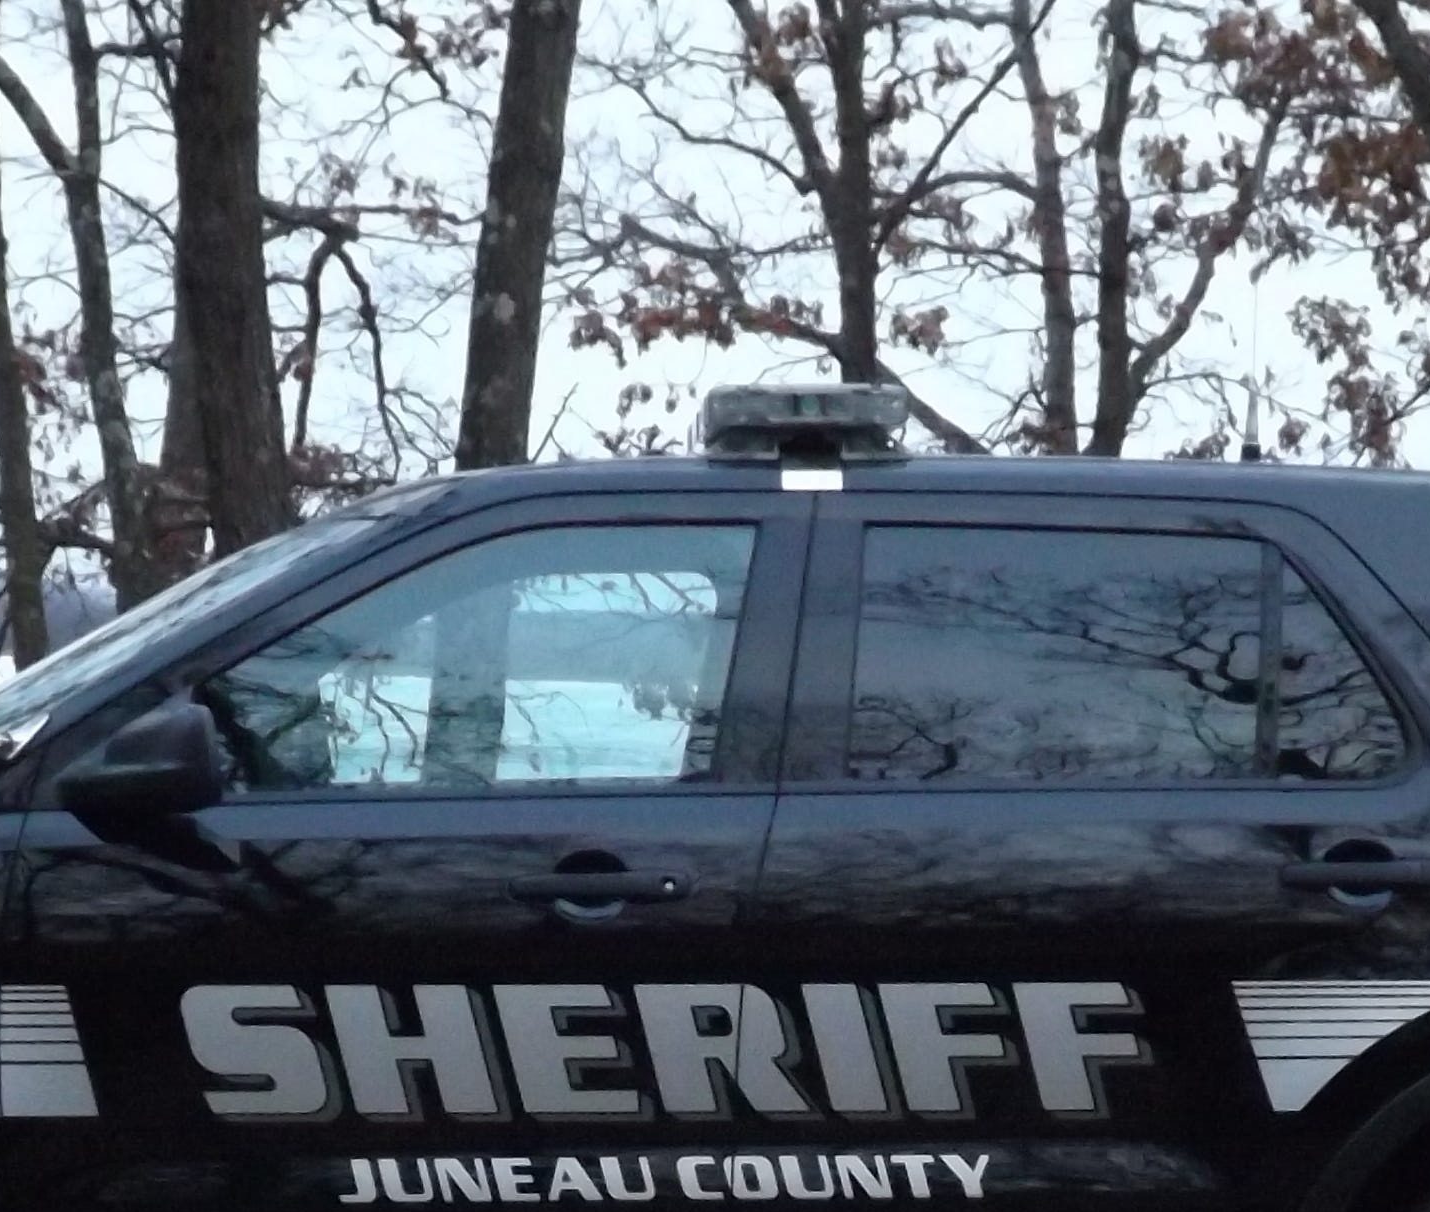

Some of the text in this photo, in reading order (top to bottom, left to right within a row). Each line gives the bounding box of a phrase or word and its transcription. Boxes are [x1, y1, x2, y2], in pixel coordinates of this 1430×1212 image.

[179, 981, 1149, 1120] SHERIFF
[338, 1152, 992, 1204] JUNEAU COUNTY
